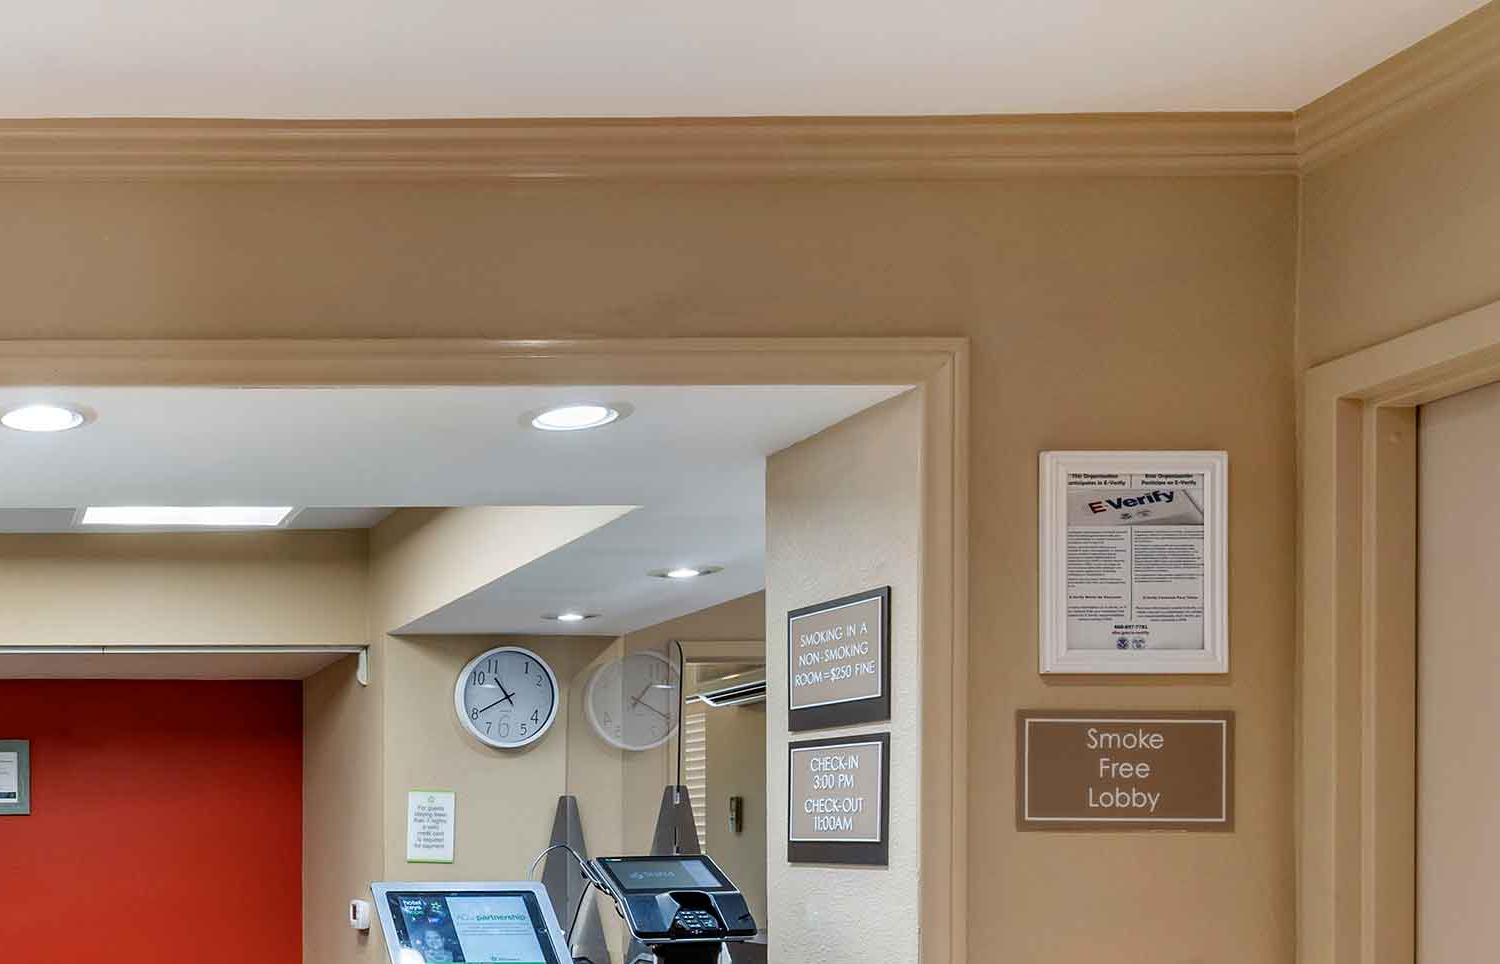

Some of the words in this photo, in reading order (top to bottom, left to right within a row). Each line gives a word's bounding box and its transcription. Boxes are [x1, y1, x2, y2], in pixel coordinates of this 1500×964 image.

[1088, 490, 1174, 514] E-Verify
[800, 626, 843, 648] SMOKING
[847, 623, 856, 637] IN
[860, 622, 868, 634] A
[799, 641, 869, 667] NON-SMOKING
[488, 660, 498, 674] 11
[525, 662, 529, 674] 1
[855, 660, 875, 676] FINE
[472, 671, 485, 686] 10
[536, 675, 543, 687] 2
[471, 708, 479, 720] 8
[530, 709, 539, 724] 4
[486, 722, 493, 735] 7
[520, 724, 528, 736] 5
[1087, 727, 1164, 749] Smoke
[810, 755, 859, 772] CHECK-IN
[1099, 758, 1150, 778] Free
[813, 774, 834, 789] 3:00
[838, 774, 854, 788] PM
[804, 797, 864, 814] CHECK-OUT
[1088, 787, 1161, 812] Lobby
[476, 913, 526, 921] partnership
